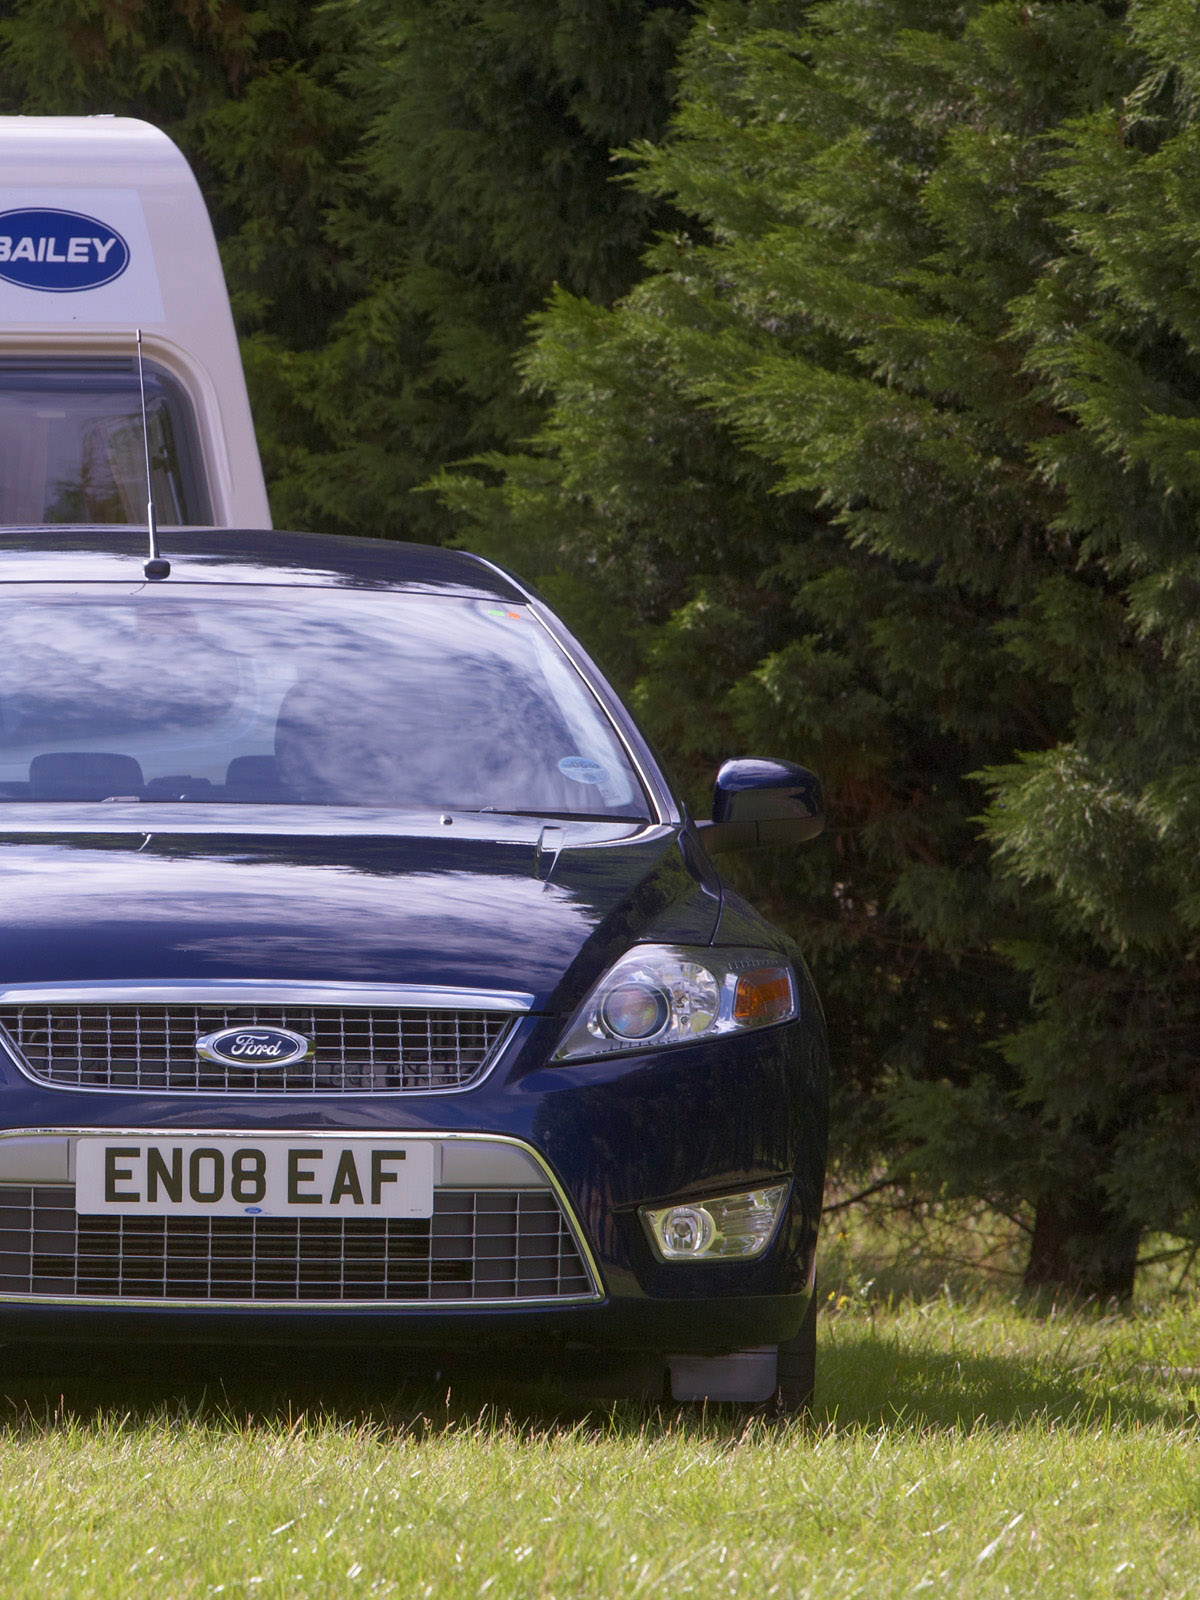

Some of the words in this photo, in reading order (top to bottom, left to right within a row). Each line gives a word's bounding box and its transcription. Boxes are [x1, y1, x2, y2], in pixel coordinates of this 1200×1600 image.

[231, 1034, 282, 1056] Ford
[105, 1147, 266, 1203] EN08
[287, 1149, 406, 1205] EAF
